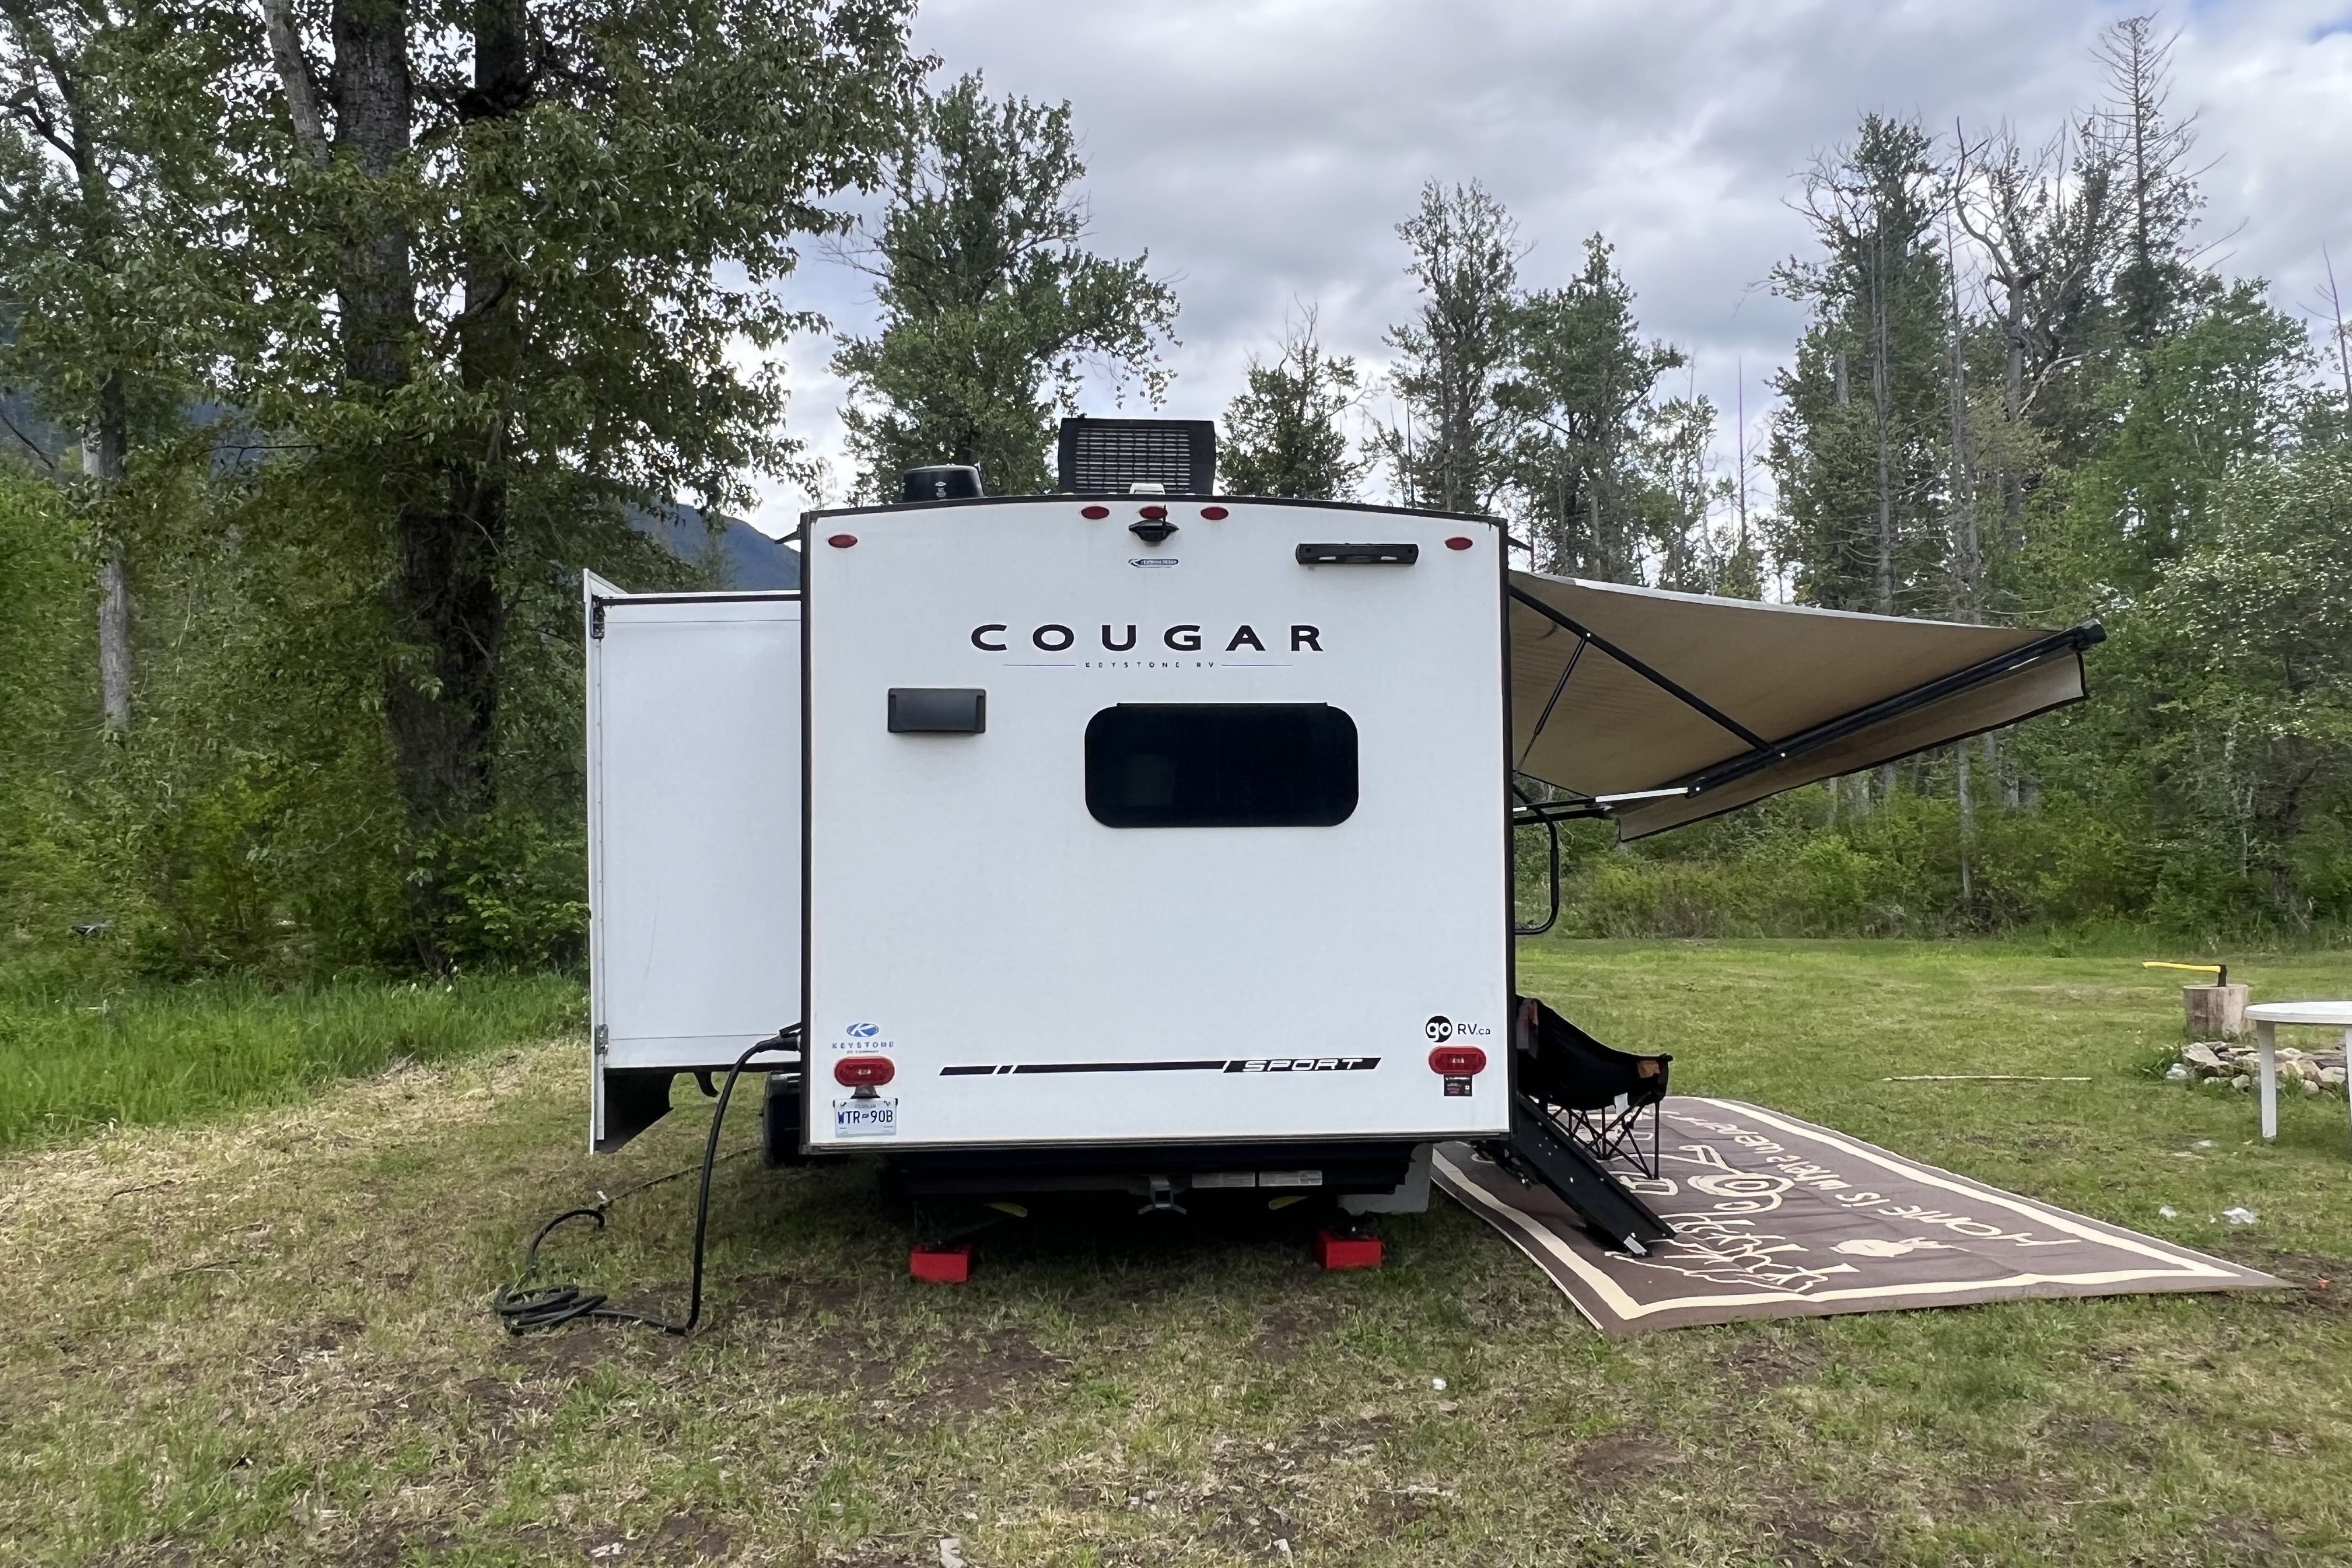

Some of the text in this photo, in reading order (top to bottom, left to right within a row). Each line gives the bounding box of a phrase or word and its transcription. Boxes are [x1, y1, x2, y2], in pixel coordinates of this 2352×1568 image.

[971, 624, 1324, 652] COUGAR
[1426, 1022, 1491, 1042] go RV.ca
[832, 1041, 894, 1049] KEYSTONE
[1242, 1058, 1363, 1072] SPORT
